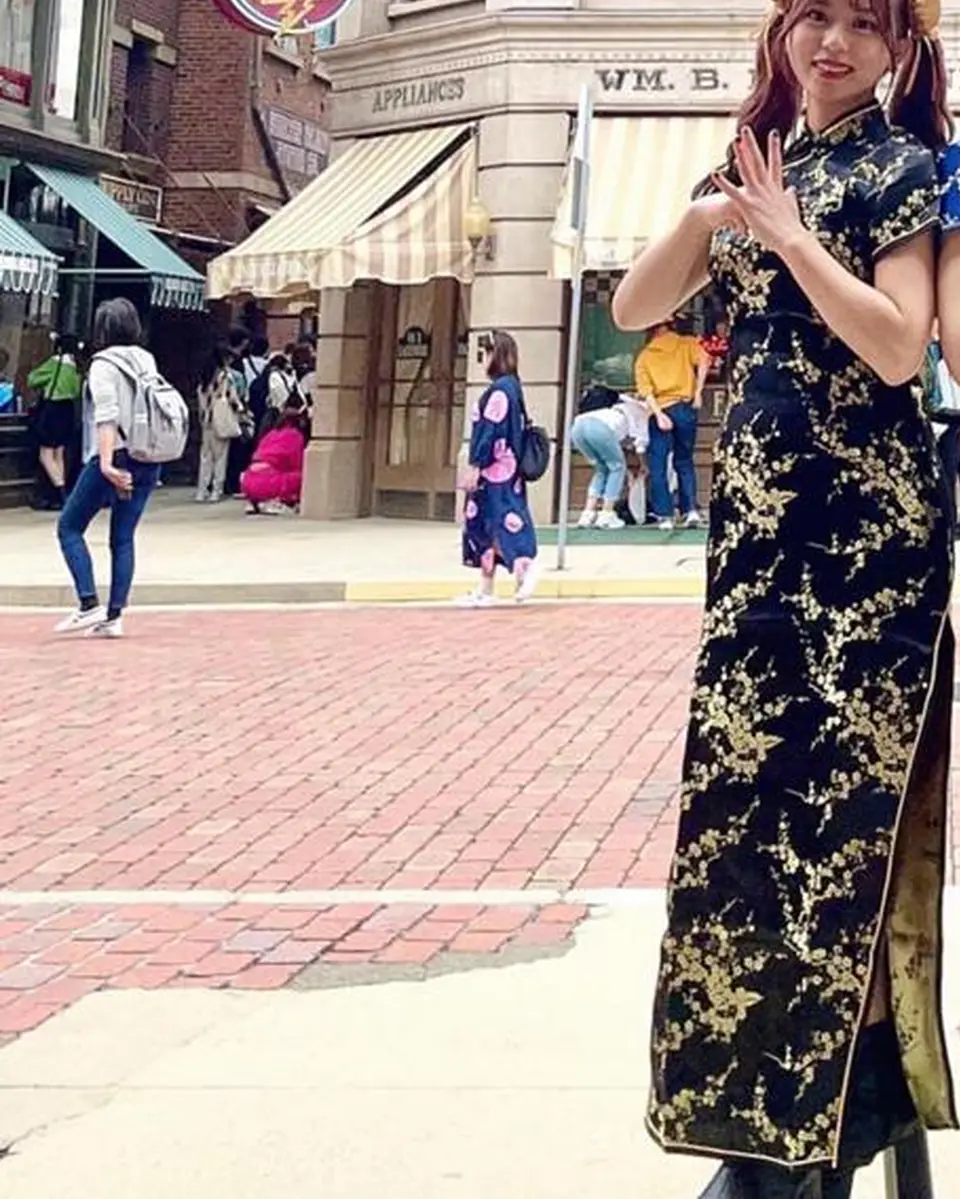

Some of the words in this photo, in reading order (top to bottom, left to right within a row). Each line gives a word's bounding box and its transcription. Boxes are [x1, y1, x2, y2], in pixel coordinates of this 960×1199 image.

[594, 68, 675, 91] WM.
[690, 68, 729, 91] B.
[371, 76, 466, 114] APPLIANCES
